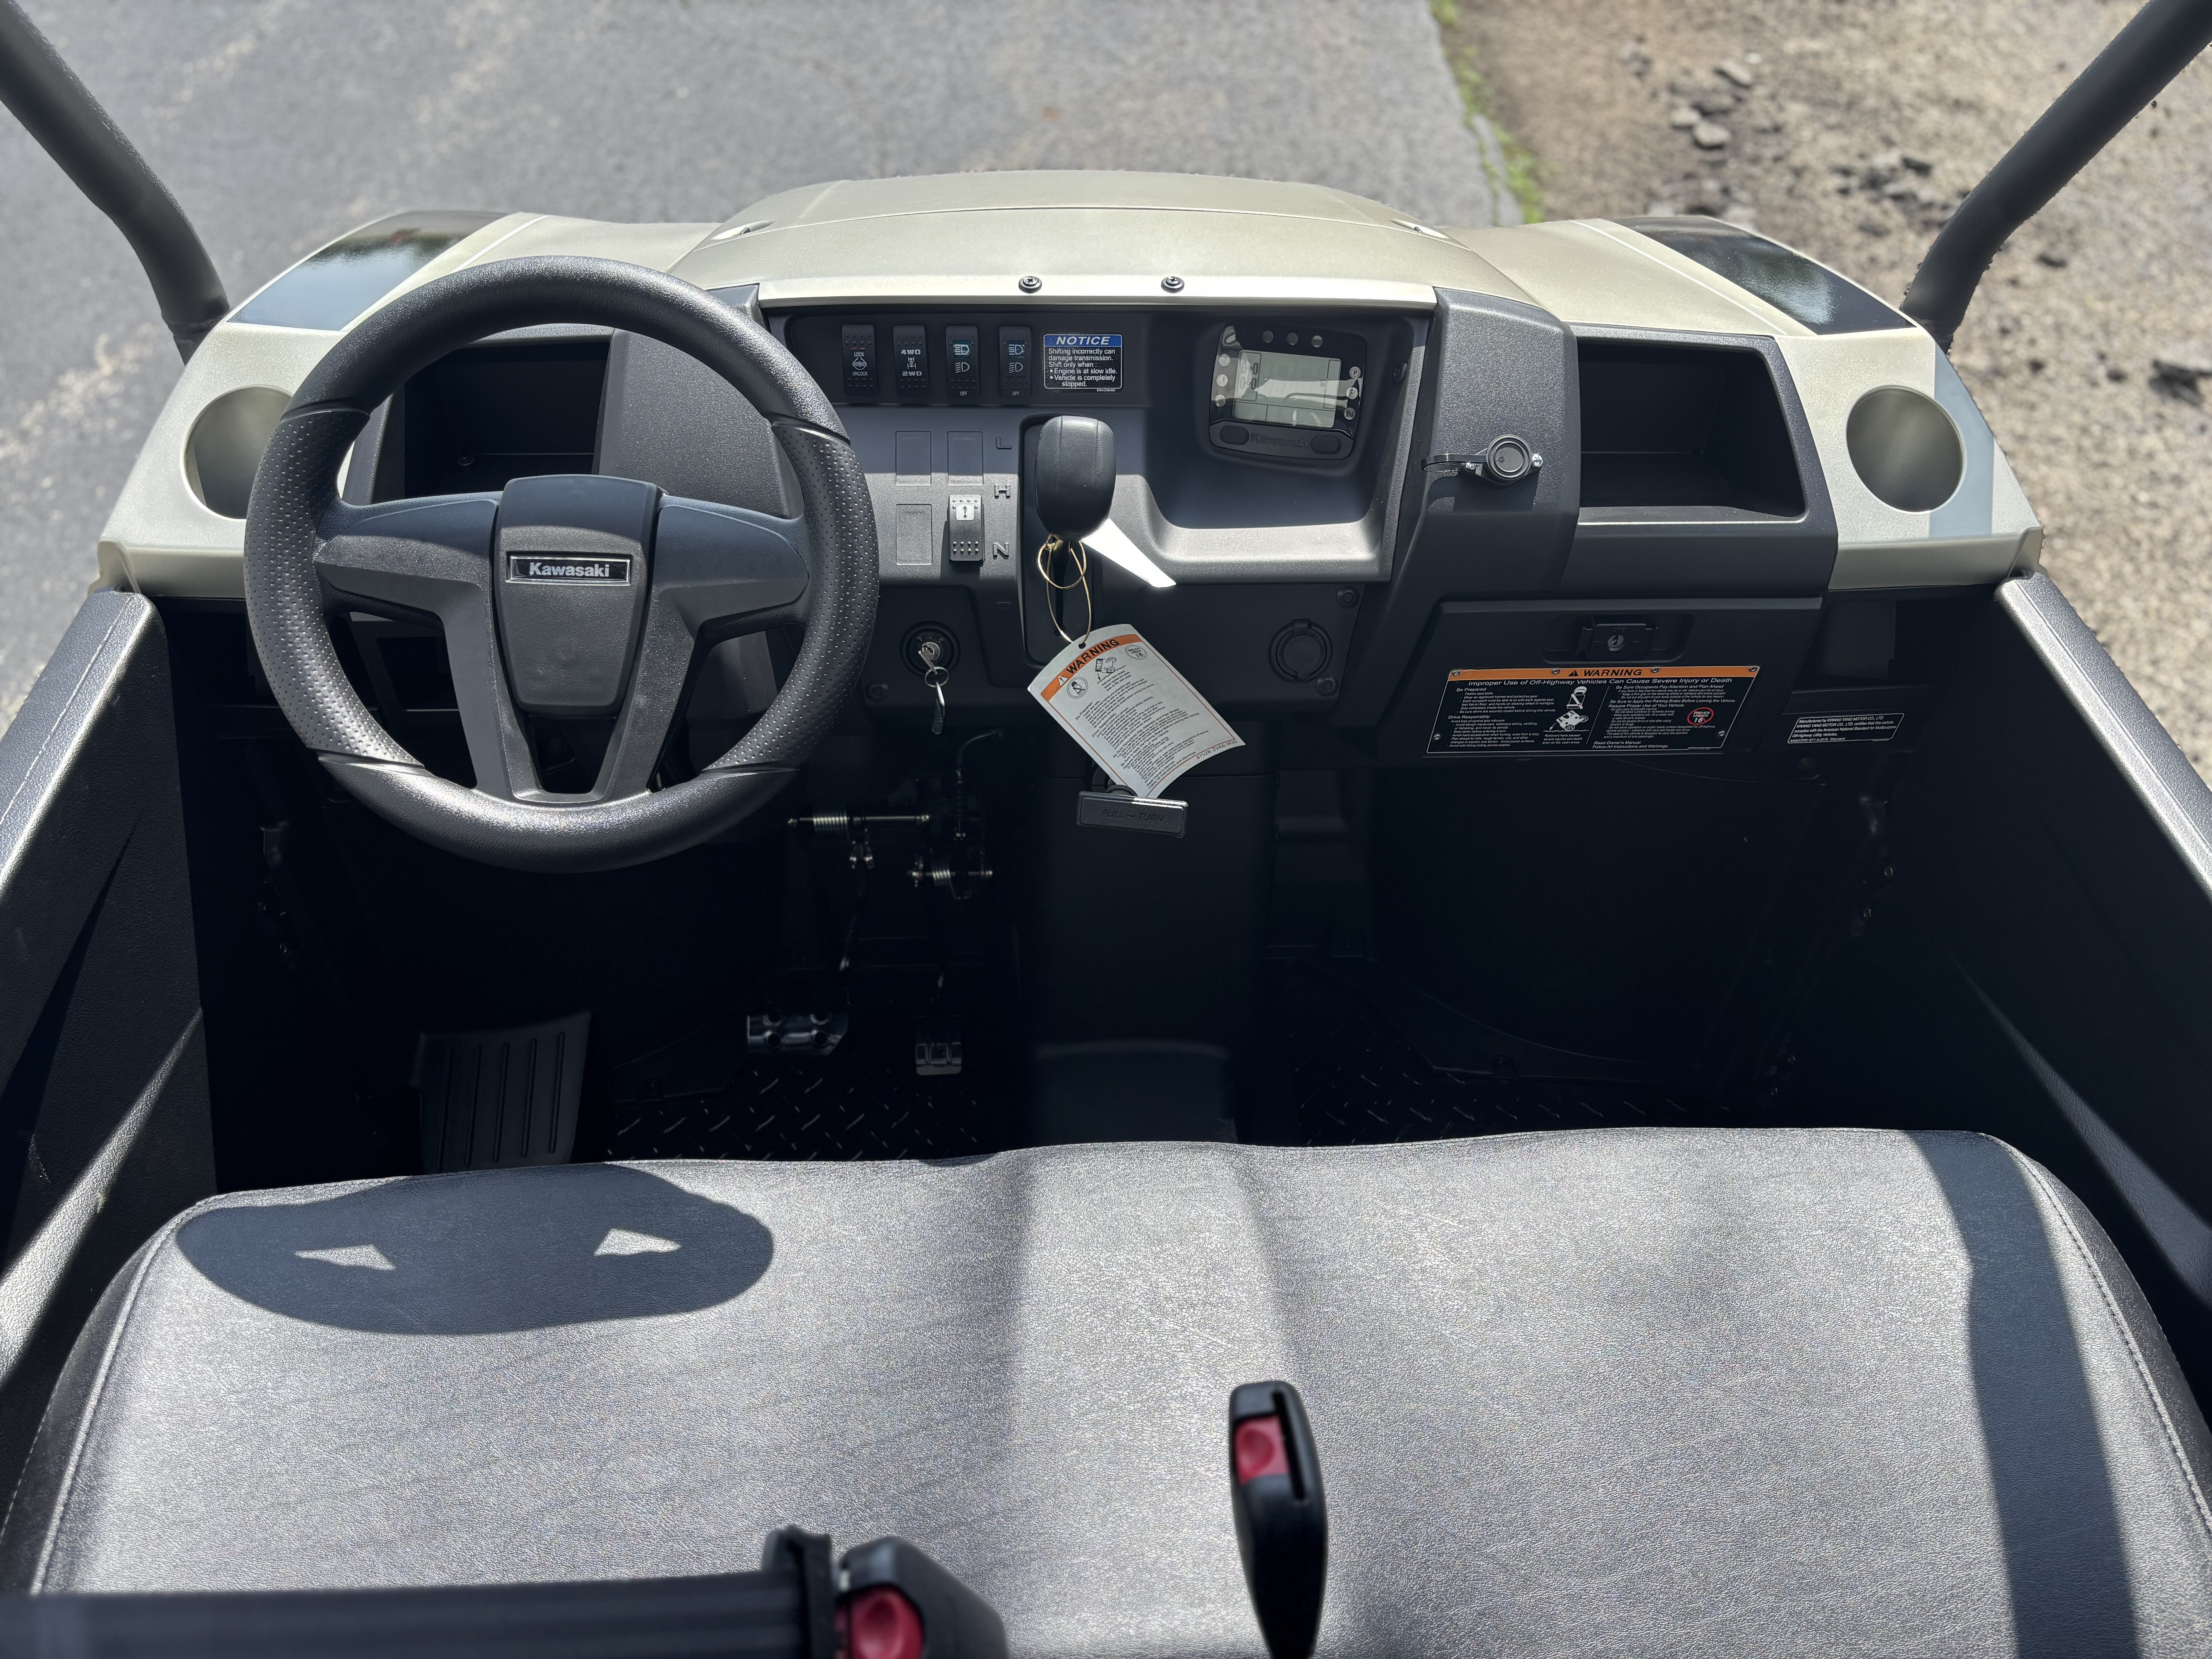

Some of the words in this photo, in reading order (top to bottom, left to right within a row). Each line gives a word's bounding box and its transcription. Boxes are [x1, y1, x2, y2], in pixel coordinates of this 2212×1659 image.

[1056, 337, 1110, 345] NOTICE
[996, 437, 1012, 449] L
[994, 484, 1010, 498] H
[993, 542, 1010, 559] N
[529, 562, 609, 577] Kawasaki
[1066, 639, 1120, 674] WARNING
[1101, 809, 1123, 818] PULL
[1139, 812, 1164, 821] TURN
